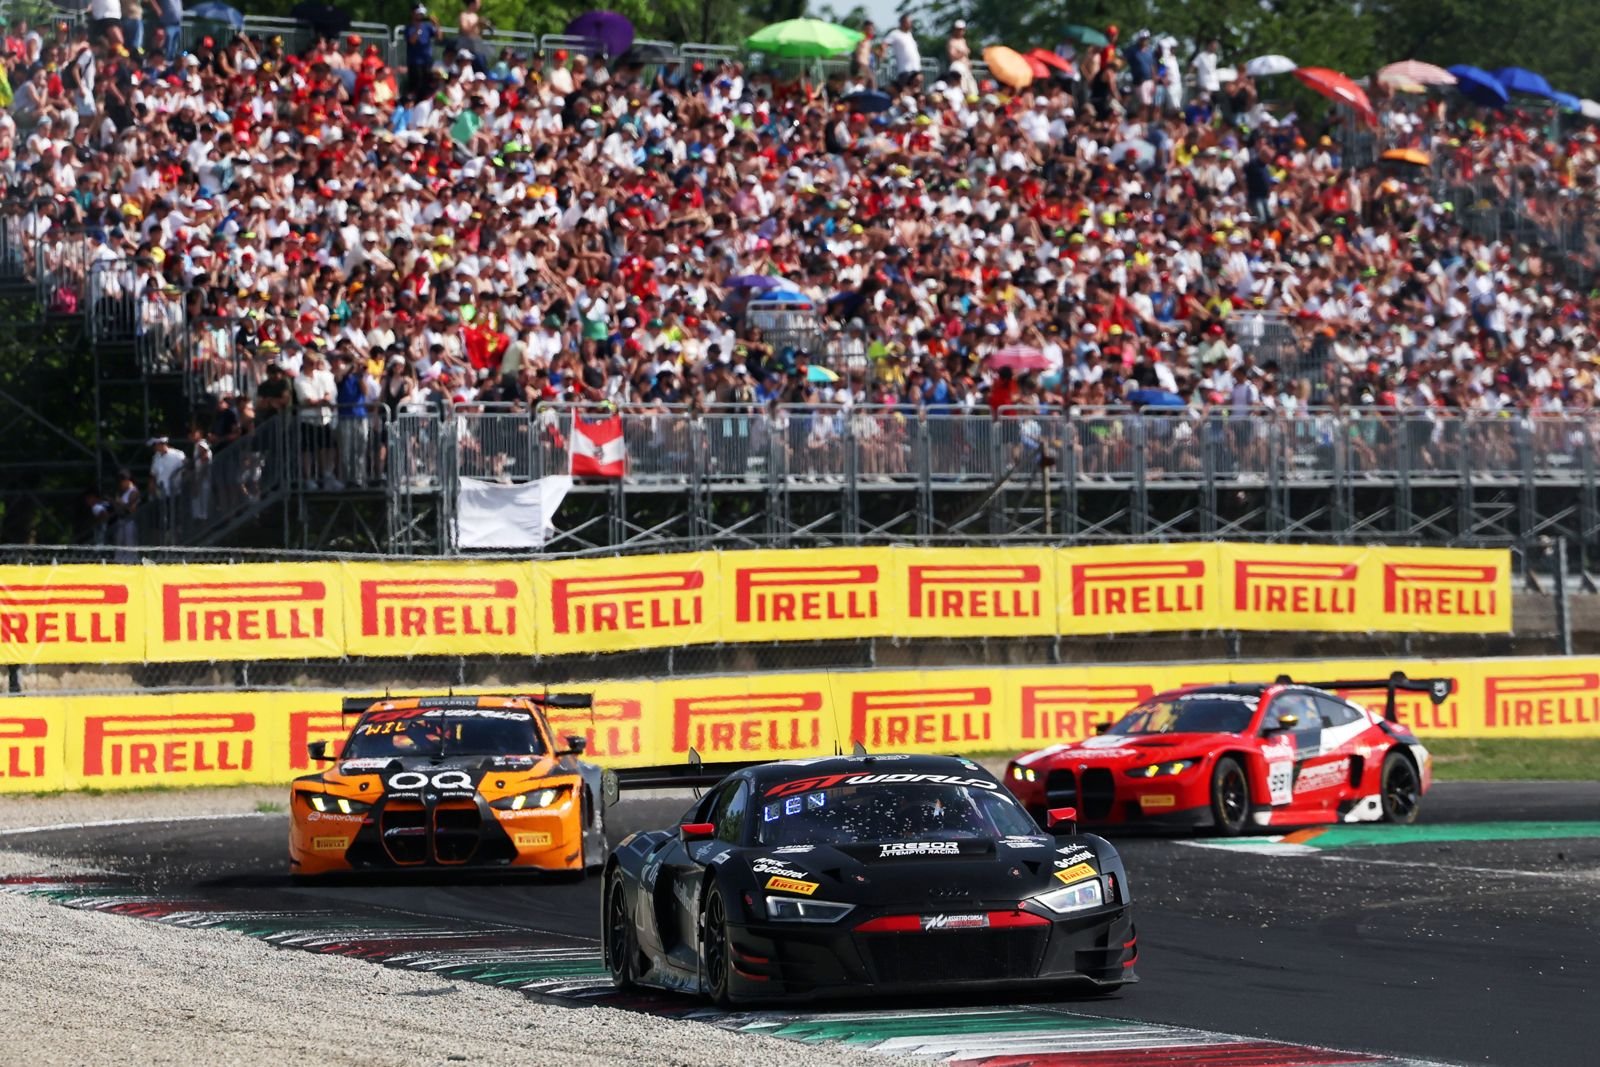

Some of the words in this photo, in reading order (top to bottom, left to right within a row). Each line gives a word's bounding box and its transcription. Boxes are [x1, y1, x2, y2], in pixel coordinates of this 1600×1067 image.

[0, 584, 129, 644] RELLI
[162, 581, 326, 641] PIRELLI
[361, 580, 518, 636] PIRELLI
[551, 571, 704, 634] PIRELLI
[736, 565, 879, 622] PIRELLI
[908, 565, 1041, 618] PIRELLI
[1071, 560, 1205, 616] PIRELLI
[1235, 560, 1358, 613] PIRELLI
[1384, 564, 1497, 615] PIRELLI
[673, 692, 823, 754] PIRELLI
[850, 687, 992, 748] PIRELLI
[1021, 684, 1154, 739] PIRE
[1485, 673, 1600, 727] PIRELLI
[83, 713, 256, 776] PIRELLI
[548, 700, 641, 757] ELLI
[387, 771, 476, 790] OQ
[763, 866, 809, 879] Castrol
[879, 841, 959, 851] TRESOR
[879, 849, 926, 858] ATTEMPTO
[927, 847, 960, 855] RACING
[1060, 865, 1092, 881] PIRELLI
[770, 878, 813, 892] PIRELLI
